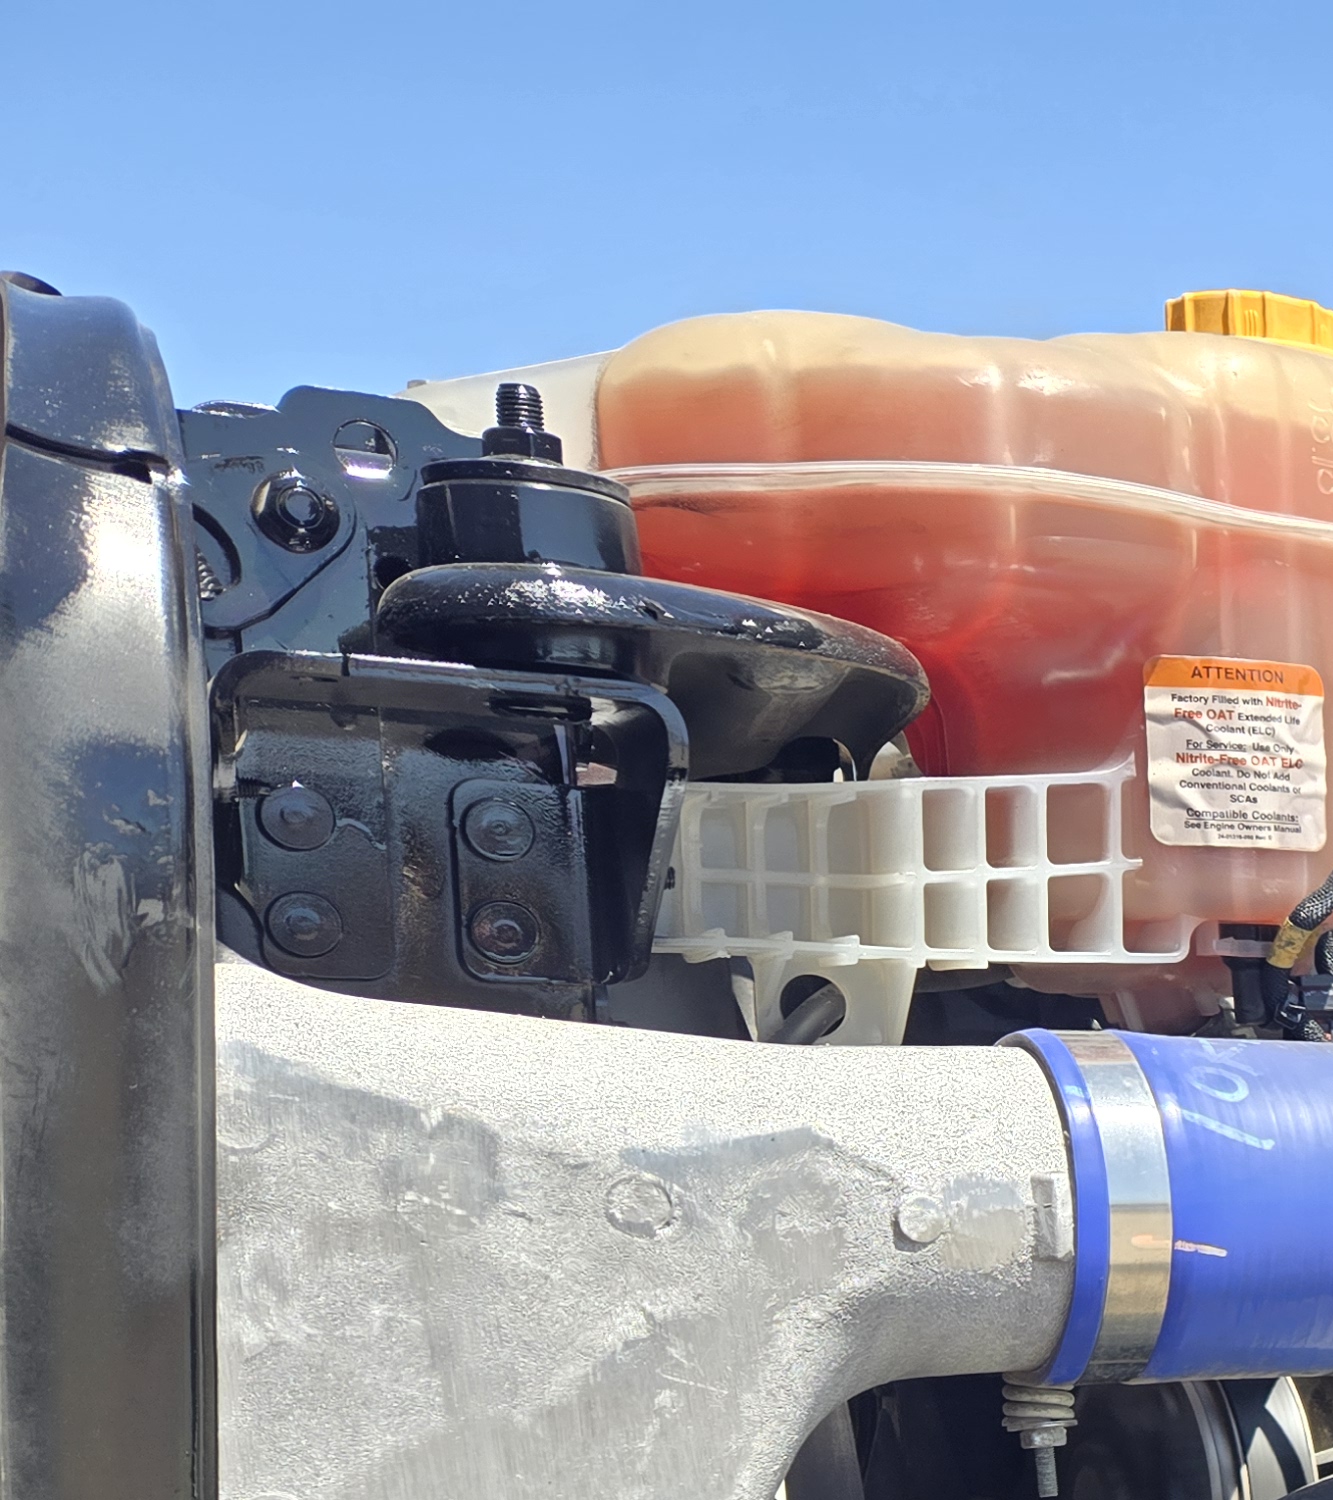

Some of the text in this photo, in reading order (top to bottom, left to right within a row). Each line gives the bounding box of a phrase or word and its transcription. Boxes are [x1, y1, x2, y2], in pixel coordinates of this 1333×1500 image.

[1191, 666, 1284, 684] ATTENTION
[1171, 694, 1302, 710] Factory Filled with Nitrite-
[1174, 708, 1300, 725] Free OAT Extended Life
[1206, 724, 1276, 737] Coolant (ELC)
[1186, 740, 1294, 755] For Service: Use Only
[1176, 753, 1303, 769] Nitrite-Free OAT ELC
[1192, 768, 1290, 781] Coolant. Do Not Add
[1179, 780, 1246, 791] Conventional
[1249, 782, 1290, 794] Coolants
[1230, 794, 1258, 804] SCAs
[1186, 808, 1299, 822] Compatible Coolants:
[1184, 821, 1302, 833] See Engine Owners Manual
